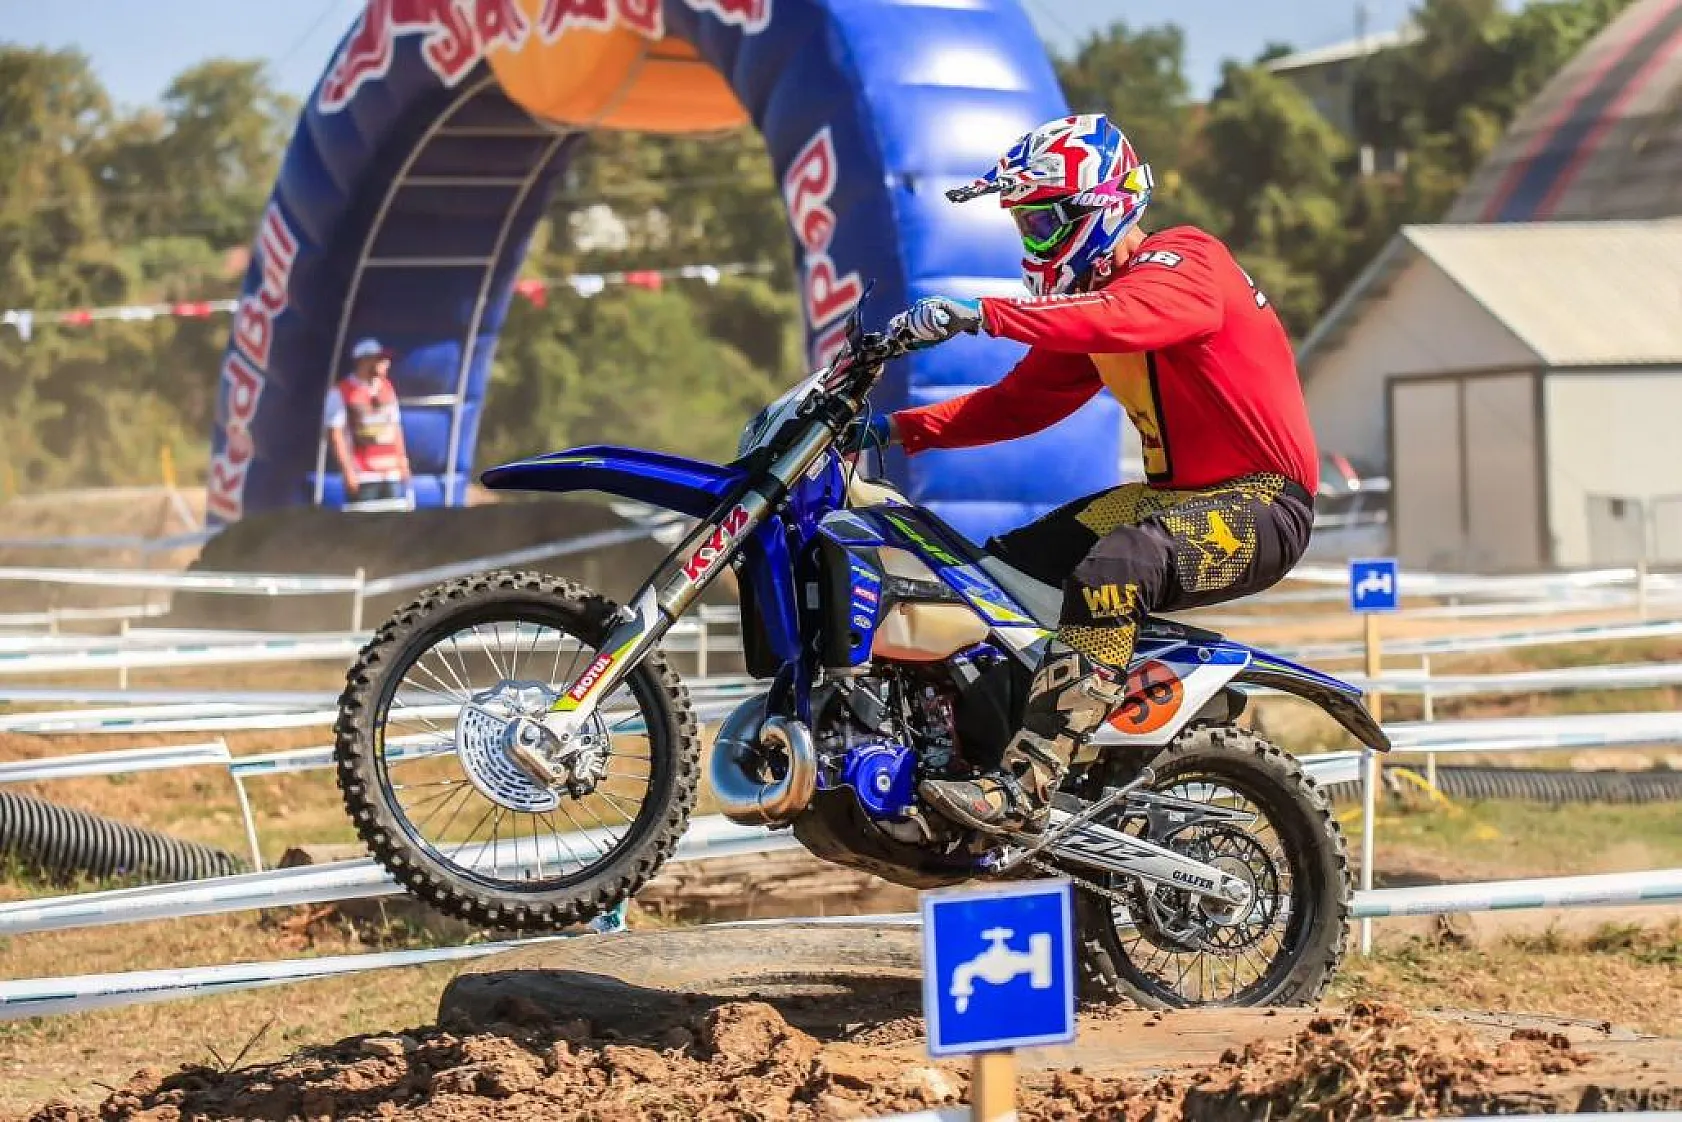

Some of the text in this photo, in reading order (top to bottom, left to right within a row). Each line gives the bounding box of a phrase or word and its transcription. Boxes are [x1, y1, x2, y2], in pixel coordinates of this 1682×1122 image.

[784, 125, 863, 330] Red
[205, 202, 299, 522] Red Bull
[681, 503, 750, 584] KYB
[572, 655, 612, 699] MOTUL
[1172, 869, 1214, 890] GALFER
